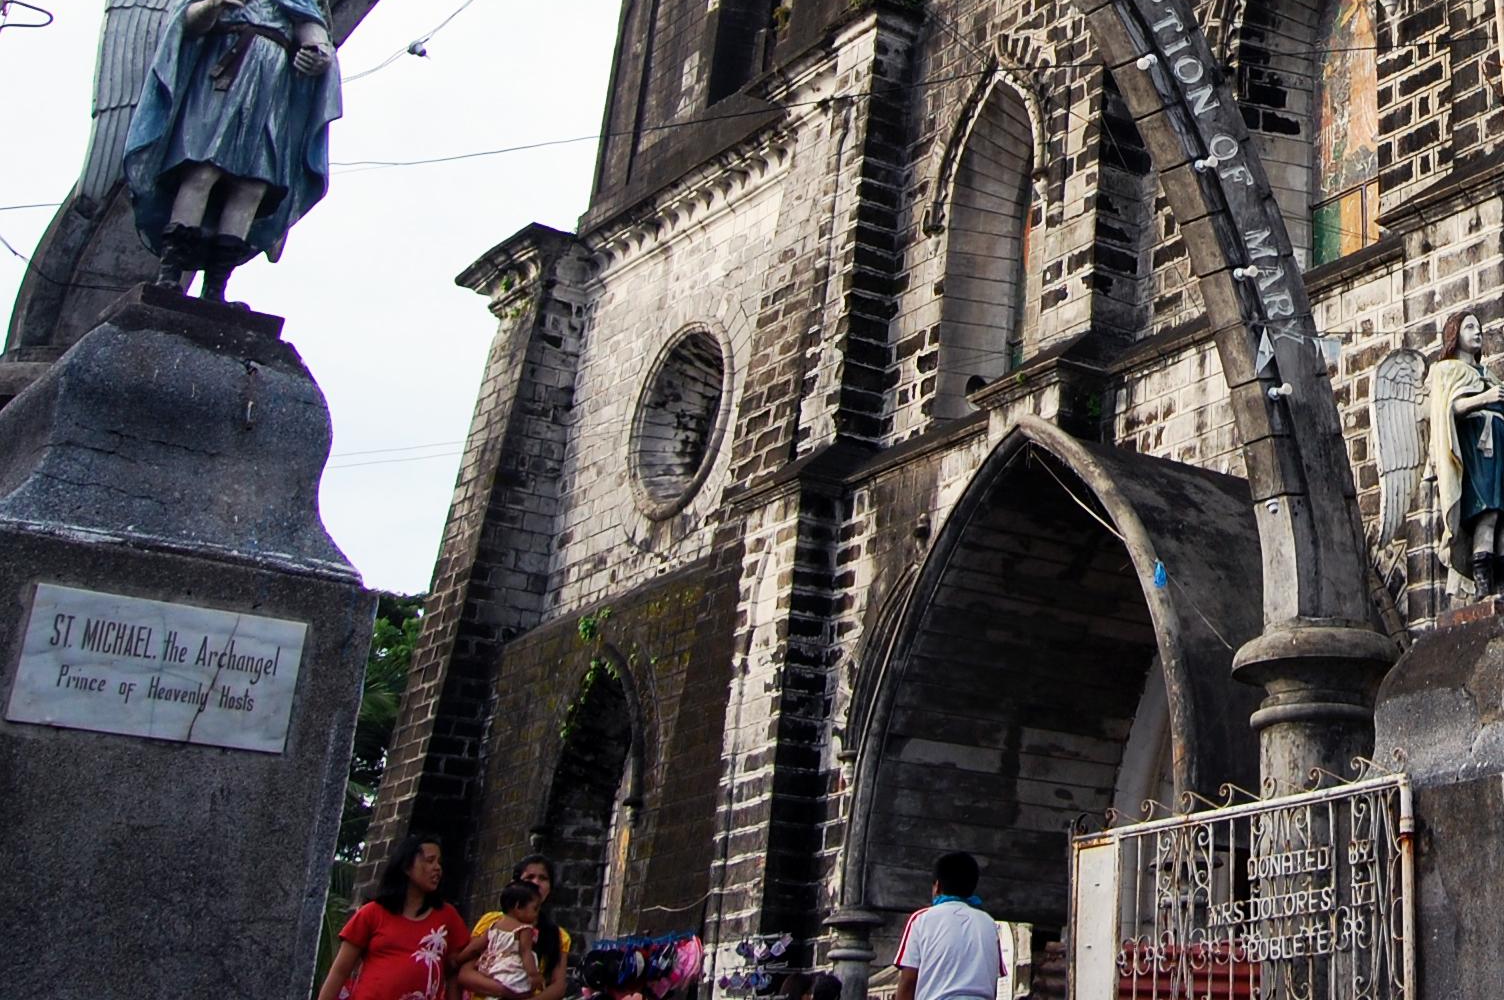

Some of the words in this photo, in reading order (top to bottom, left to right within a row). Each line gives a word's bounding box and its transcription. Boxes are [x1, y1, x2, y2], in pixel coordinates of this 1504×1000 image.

[1209, 133, 1254, 186] OF
[1244, 226, 1305, 344] MARY
[50, 613, 76, 648] ST.
[163, 630, 188, 663] the
[195, 635, 281, 685] Archangel
[56, 664, 106, 692] Prince
[147, 676, 208, 713] Heavenly
[218, 685, 255, 712] Hosts
[1247, 847, 1331, 881] DONATED
[1348, 840, 1371, 864] BY
[1249, 886, 1332, 922] DOLORES
[1247, 931, 1331, 963] POBLETE
